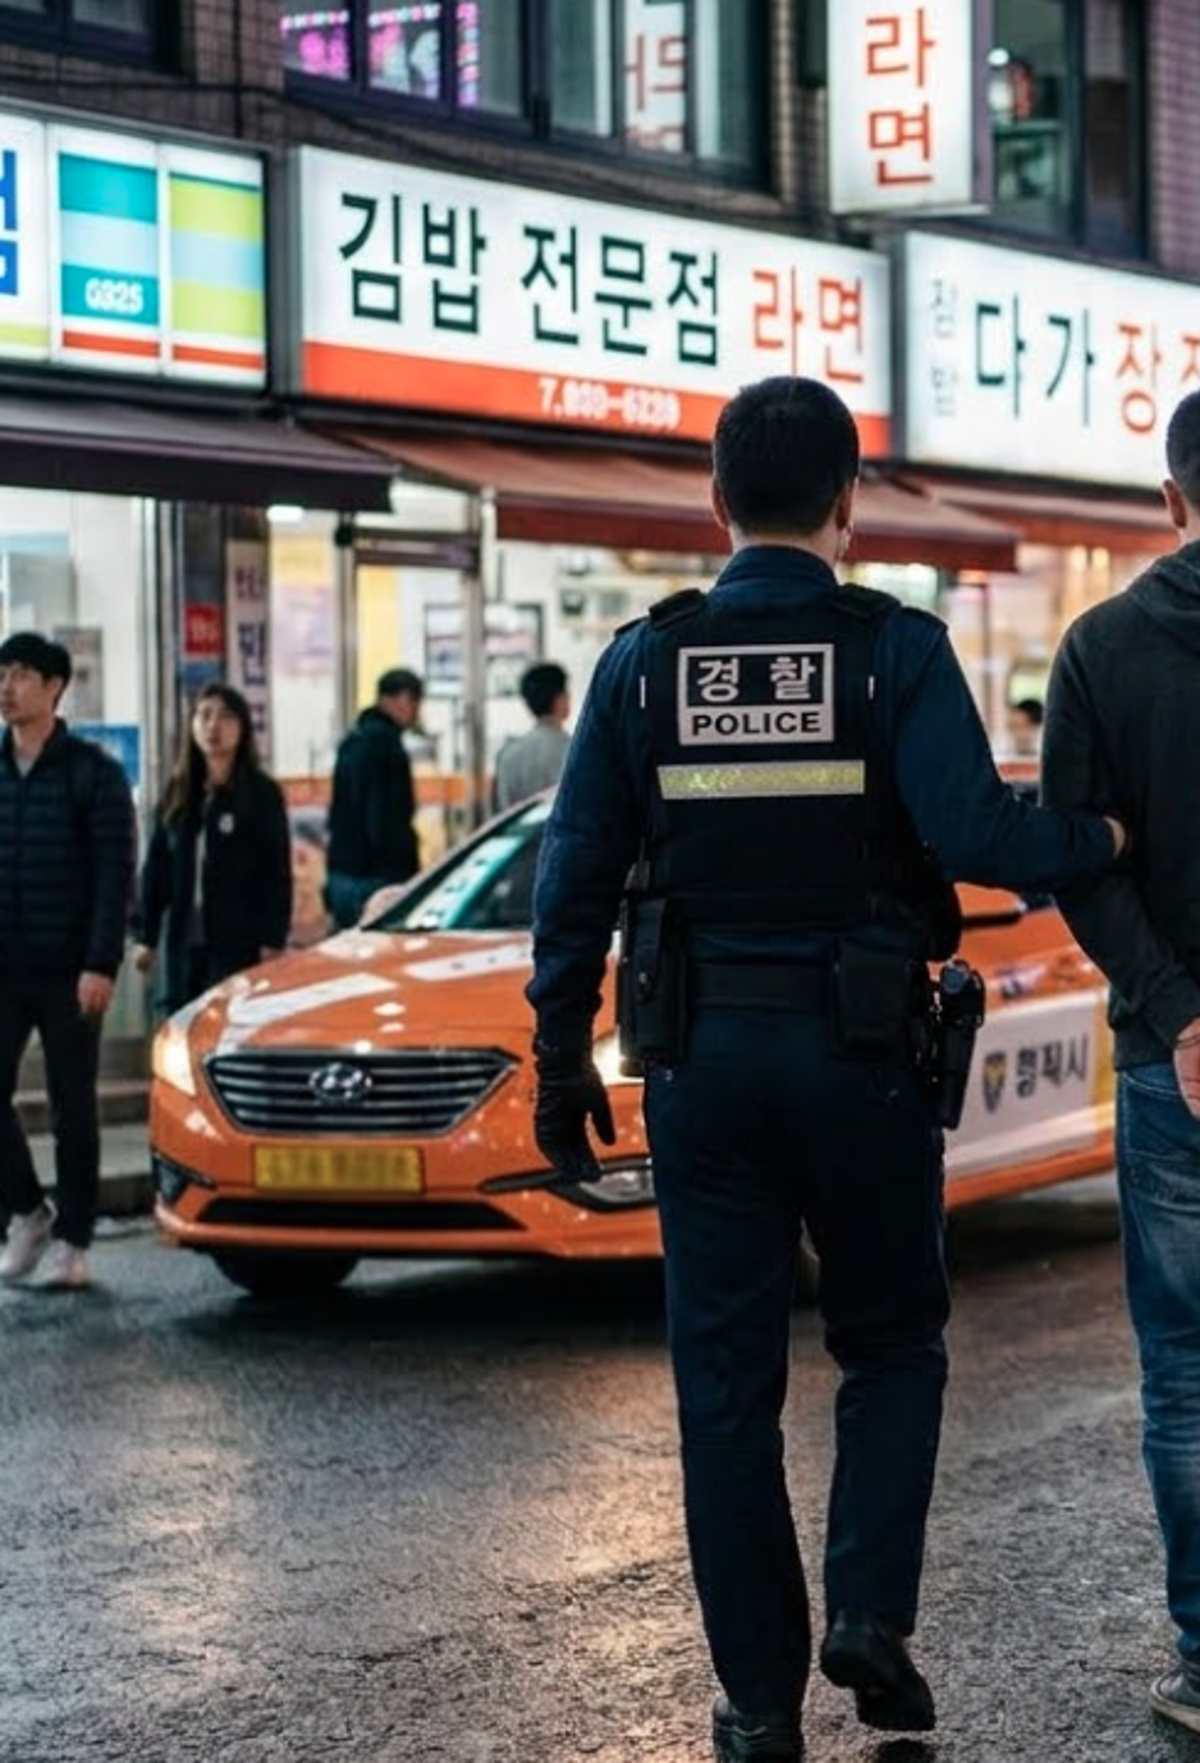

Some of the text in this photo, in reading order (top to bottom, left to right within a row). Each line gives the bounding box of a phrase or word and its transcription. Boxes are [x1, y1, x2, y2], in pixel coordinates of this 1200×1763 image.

[865, 7, 936, 188] 라면
[339, 191, 487, 335] 김밥
[520, 223, 718, 367] 전문점
[752, 264, 864, 384] 라면
[691, 711, 821, 736] POLICE
[696, 656, 817, 703] 경찰
